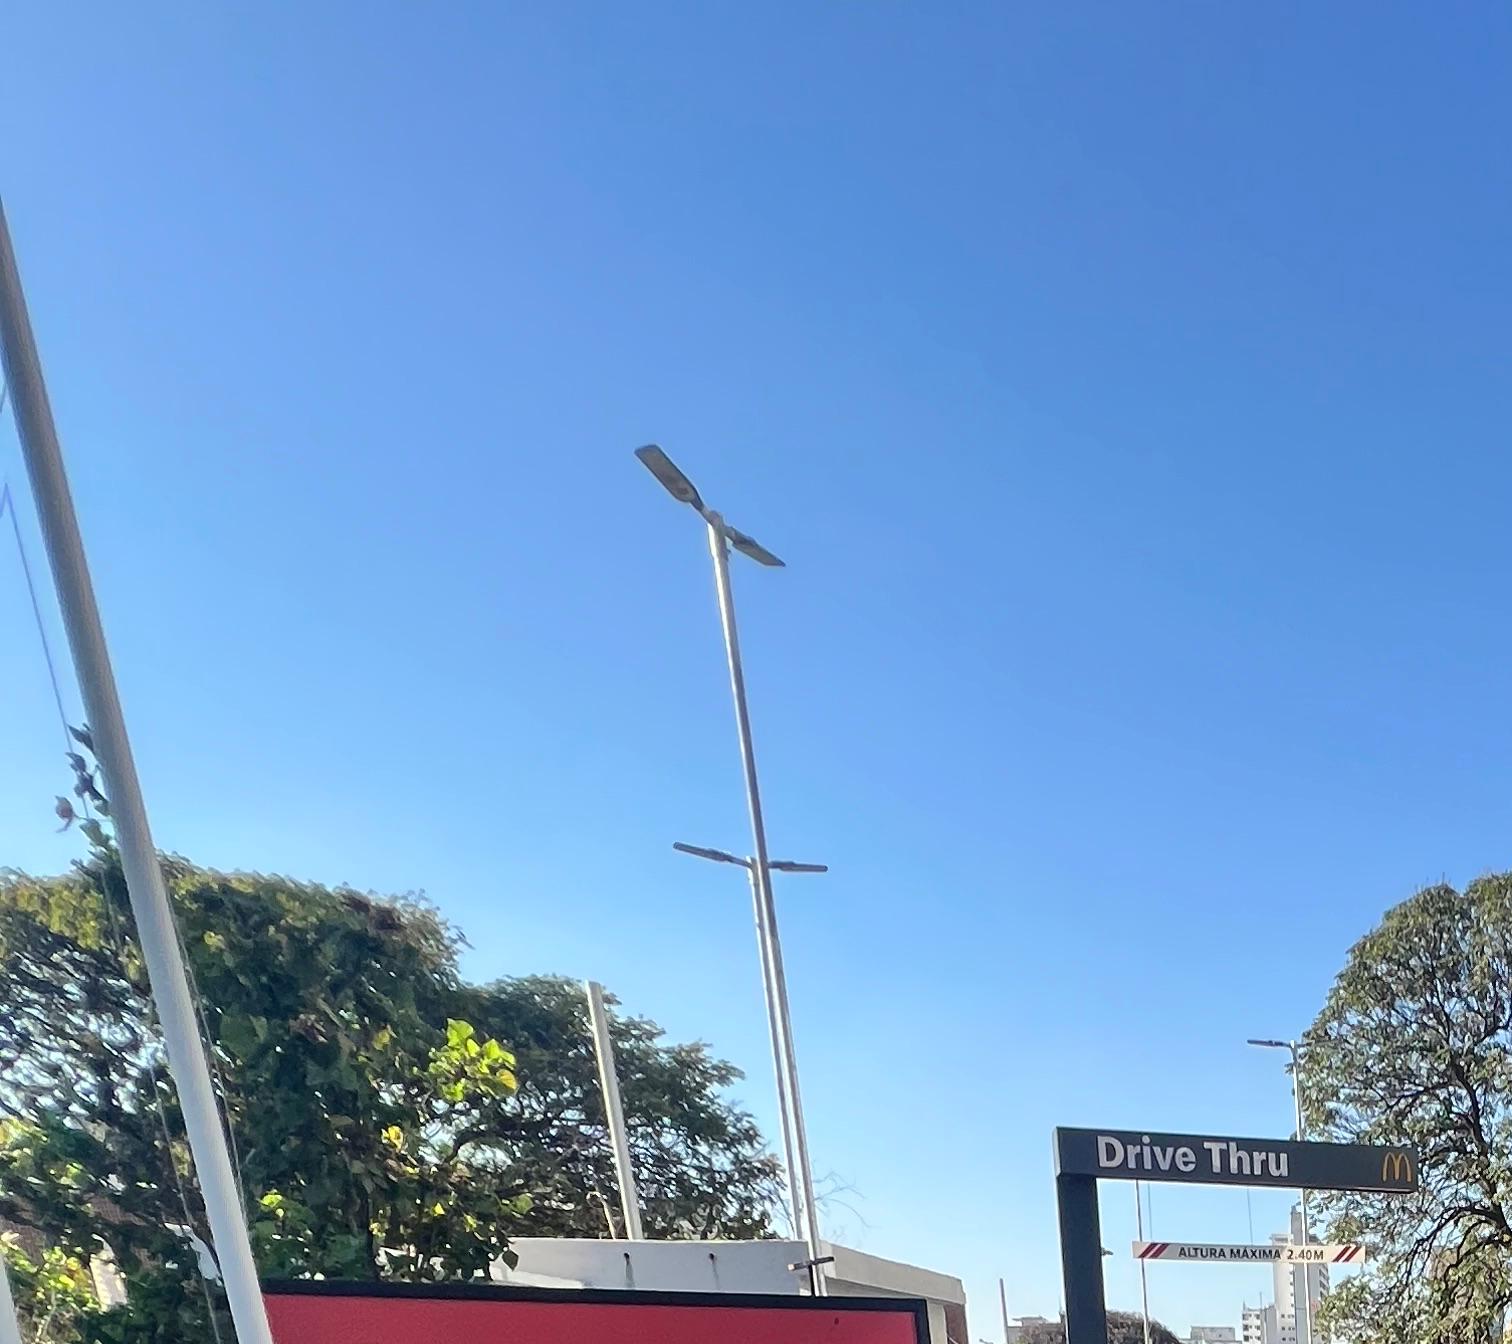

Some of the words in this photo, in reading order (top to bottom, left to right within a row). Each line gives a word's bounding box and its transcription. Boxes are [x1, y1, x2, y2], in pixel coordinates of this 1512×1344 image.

[1097, 1134, 1197, 1173] Drive
[1203, 1141, 1290, 1178] Thru
[1178, 1246, 1227, 1259] ALTURA
[1230, 1245, 1281, 1261] MÁXIMA
